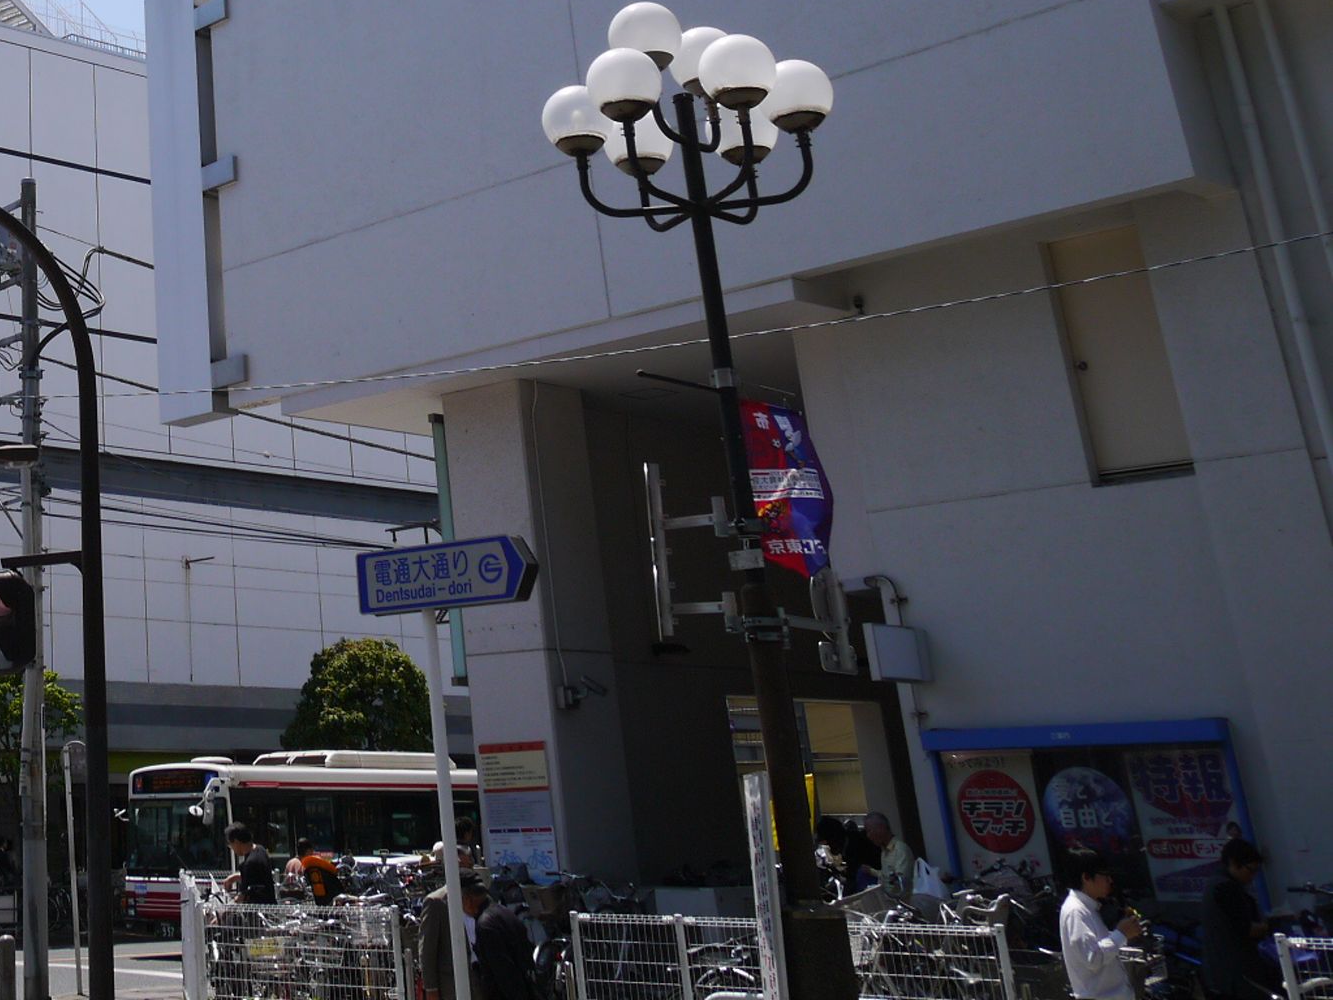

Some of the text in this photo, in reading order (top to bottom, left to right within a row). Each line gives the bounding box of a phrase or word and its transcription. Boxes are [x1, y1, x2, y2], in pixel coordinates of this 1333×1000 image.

[374, 550, 469, 586] 電通大通り
[1129, 751, 1230, 802] 特報
[962, 801, 1026, 817] チラシ
[1059, 804, 1114, 829] 自由と
[971, 818, 1027, 835] マッチ
